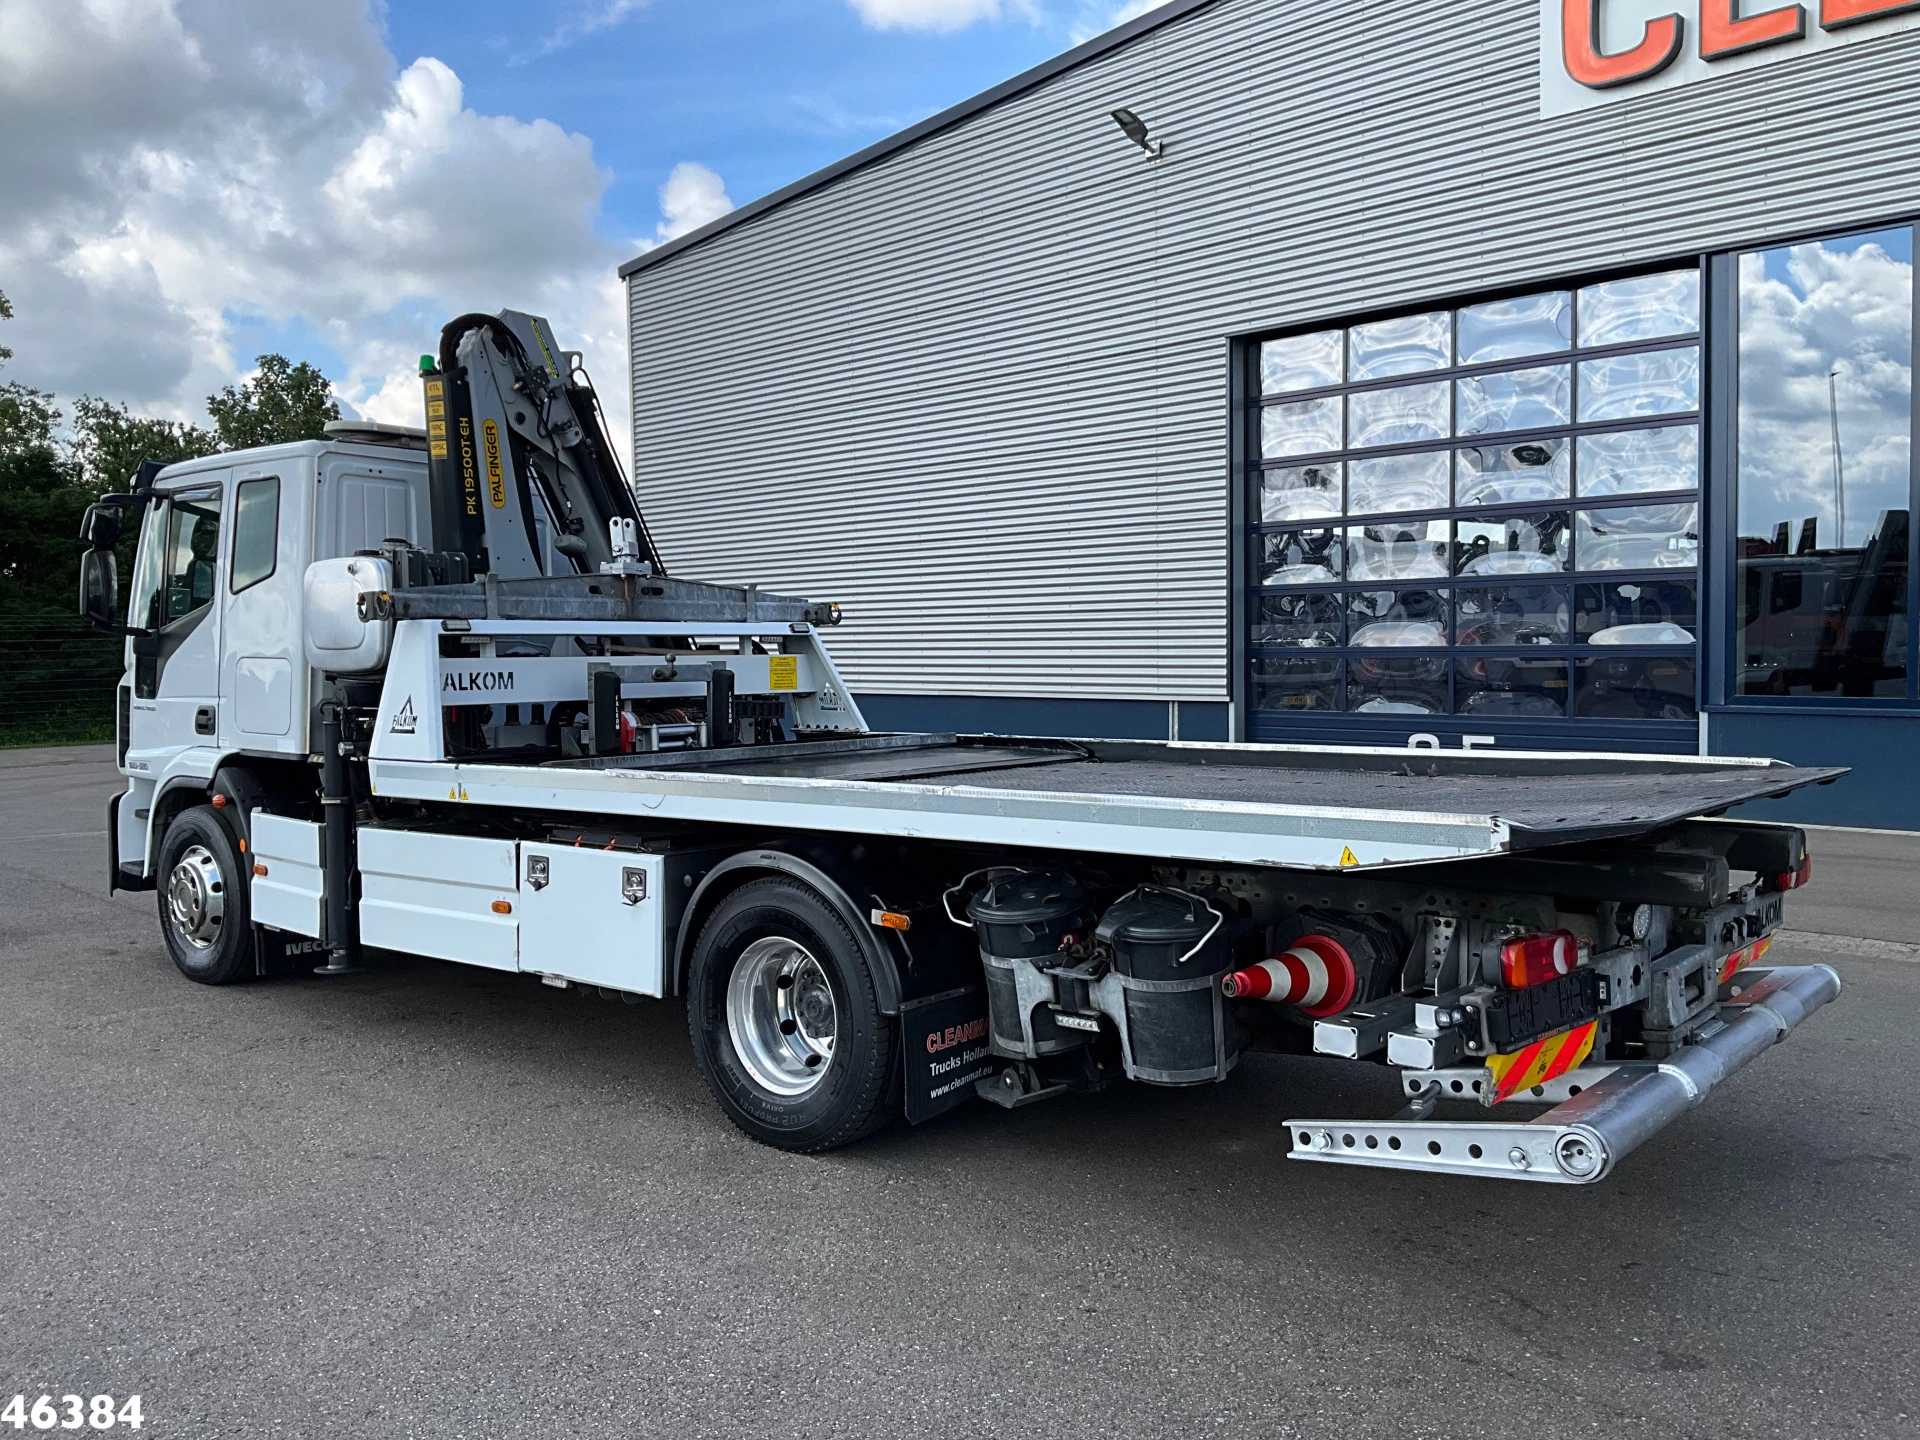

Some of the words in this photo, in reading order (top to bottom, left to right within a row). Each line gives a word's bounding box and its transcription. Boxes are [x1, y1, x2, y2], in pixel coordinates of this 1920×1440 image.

[485, 425, 503, 502] PALFINGER
[466, 496, 477, 515] PK
[442, 671, 514, 691] ALKOM
[929, 1056, 961, 1077] Trucks
[963, 1046, 990, 1065] Hollan
[930, 1065, 993, 1099] www.cleanmat.eu
